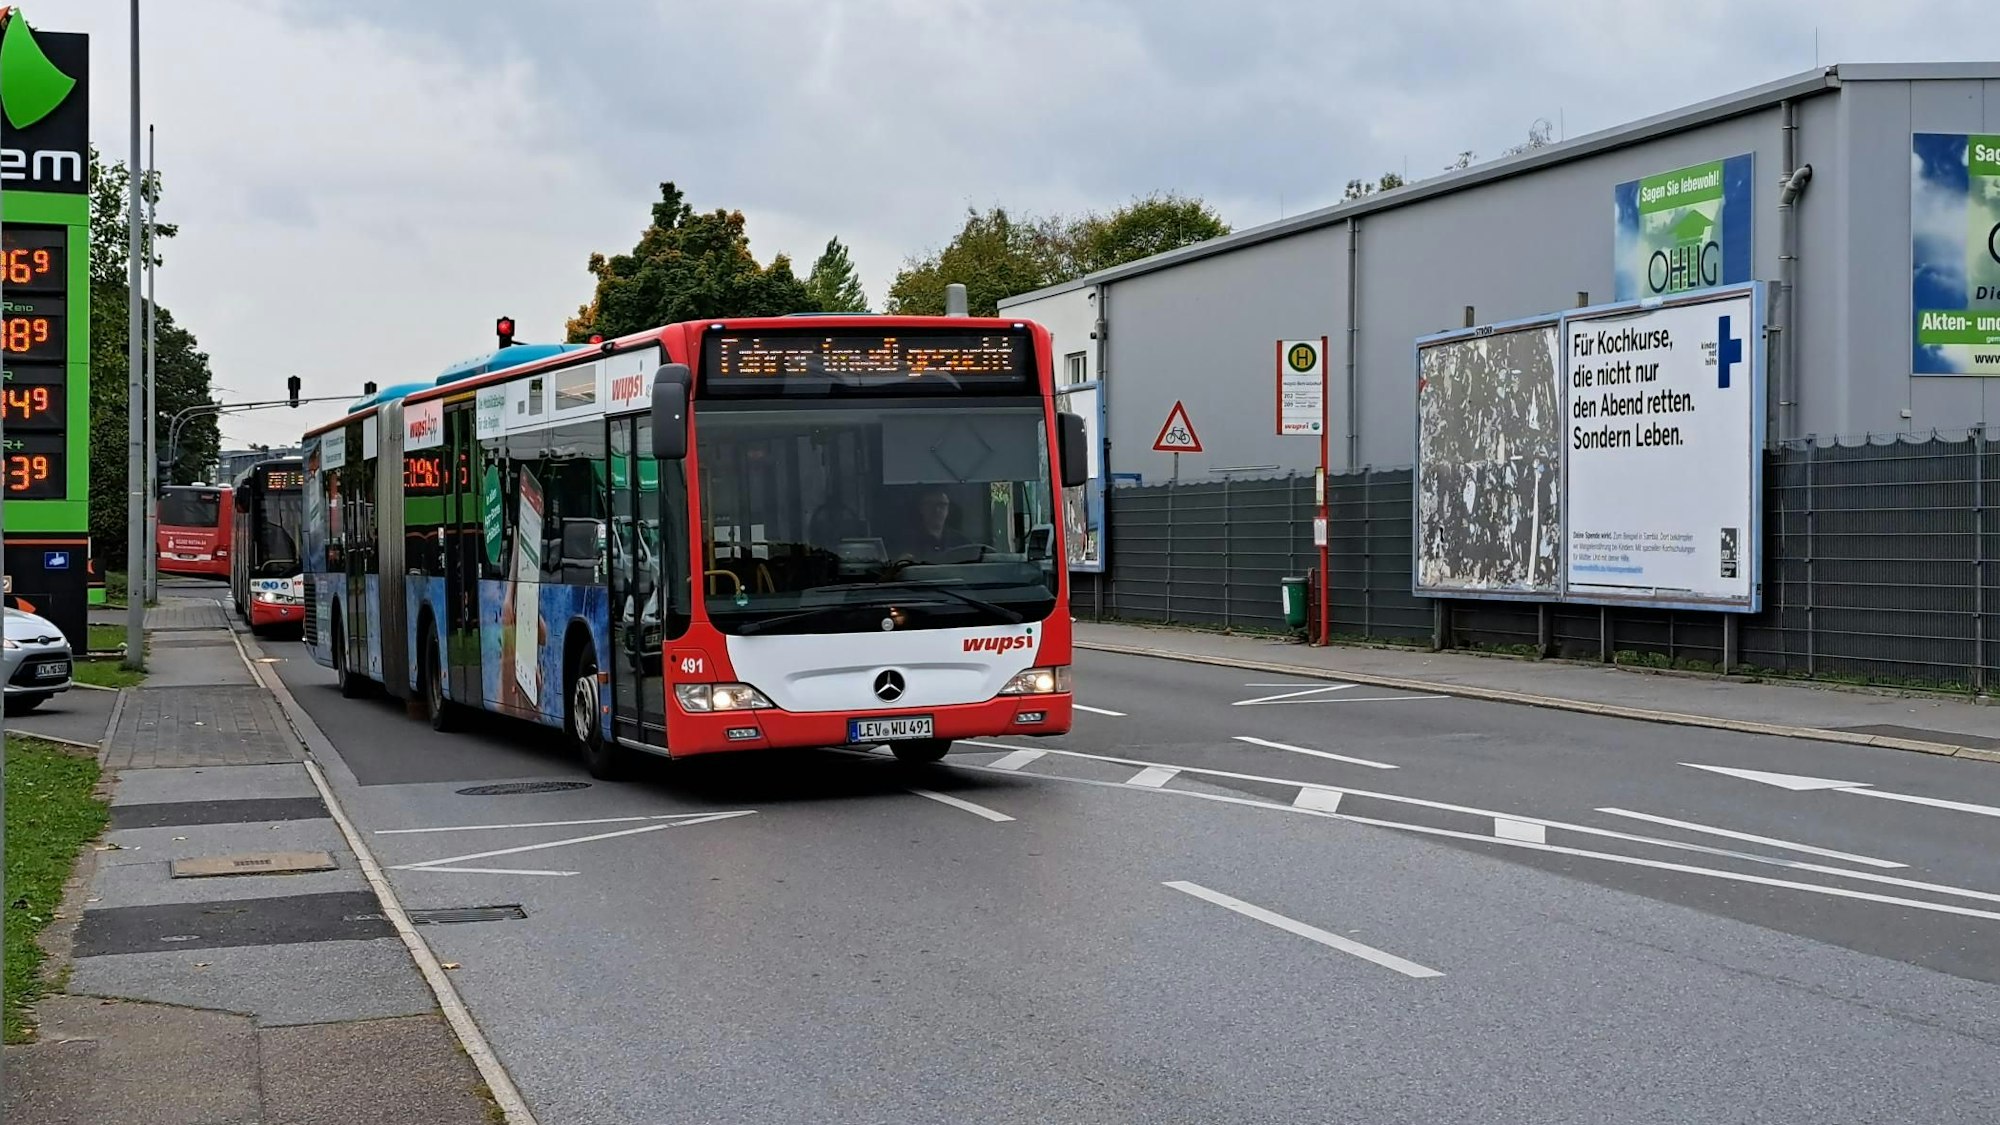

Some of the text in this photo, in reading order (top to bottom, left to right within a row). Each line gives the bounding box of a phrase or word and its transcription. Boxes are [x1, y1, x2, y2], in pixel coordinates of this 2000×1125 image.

[1641, 170, 1720, 203] Sagen Sie lebewohl!
[1648, 241, 1720, 293] OHLIG
[1922, 312, 1973, 331] Akten-
[720, 337, 814, 373] Fahrer
[907, 336, 1015, 377] gesucht
[1573, 327, 1673, 357] Für Kochkurse,
[611, 360, 643, 407] wupsi
[1573, 361, 1659, 388] die nicht nur
[1573, 389, 1695, 419] den Abend retten.
[1573, 422, 1684, 450] Sondern Leben.
[962, 627, 1034, 656] wupsi
[681, 658, 704, 674] 491
[858, 719, 931, 738] LEV WU 491
